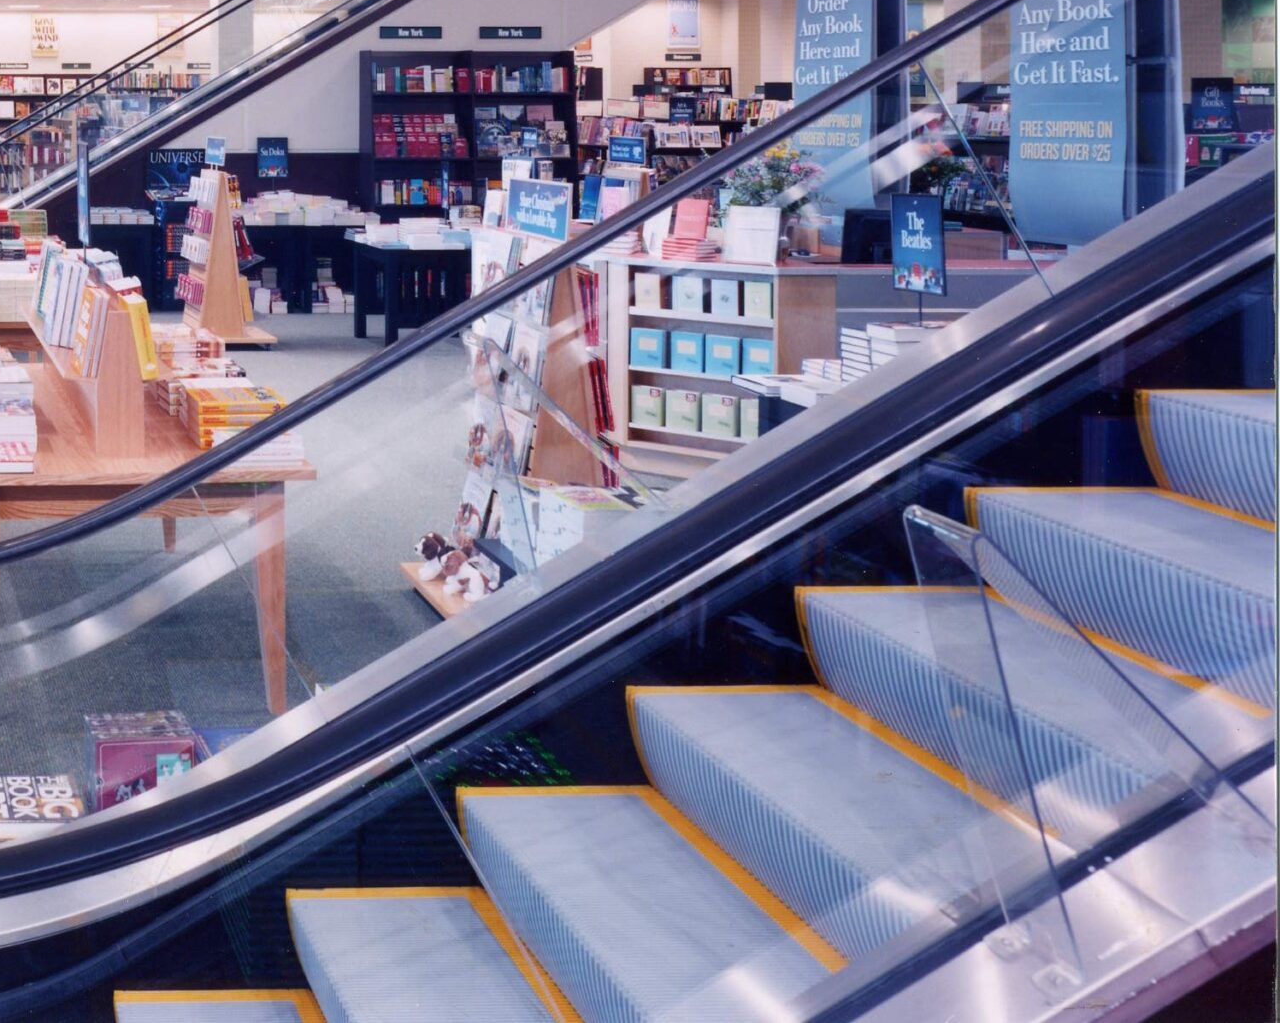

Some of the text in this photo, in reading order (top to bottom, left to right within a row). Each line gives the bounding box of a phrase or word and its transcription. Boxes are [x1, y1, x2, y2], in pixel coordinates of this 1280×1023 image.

[798, 13, 863, 41] Any Book
[1018, 3, 1054, 32] Any
[398, 28, 423, 37] New York
[498, 28, 523, 37] New York
[1020, 26, 1110, 55] Here and
[800, 38, 860, 61] Here and
[795, 65, 819, 85] Get
[820, 65, 831, 85] It
[1014, 60, 1119, 86] Get It Fast.
[1204, 86, 1221, 98] Gift
[1201, 96, 1225, 108] Books
[851, 113, 862, 128] ON
[1020, 120, 1113, 139] FREE SHIPPING ON
[827, 132, 846, 146] OVER
[847, 132, 861, 147] $25
[150, 150, 205, 164] UNIVERSE
[1020, 143, 1111, 162] ORDERS OVER $25
[906, 211, 925, 230] The
[901, 229, 932, 249] Beatles
[6, 776, 40, 819] BOOK
[39, 784, 79, 819] BIG
